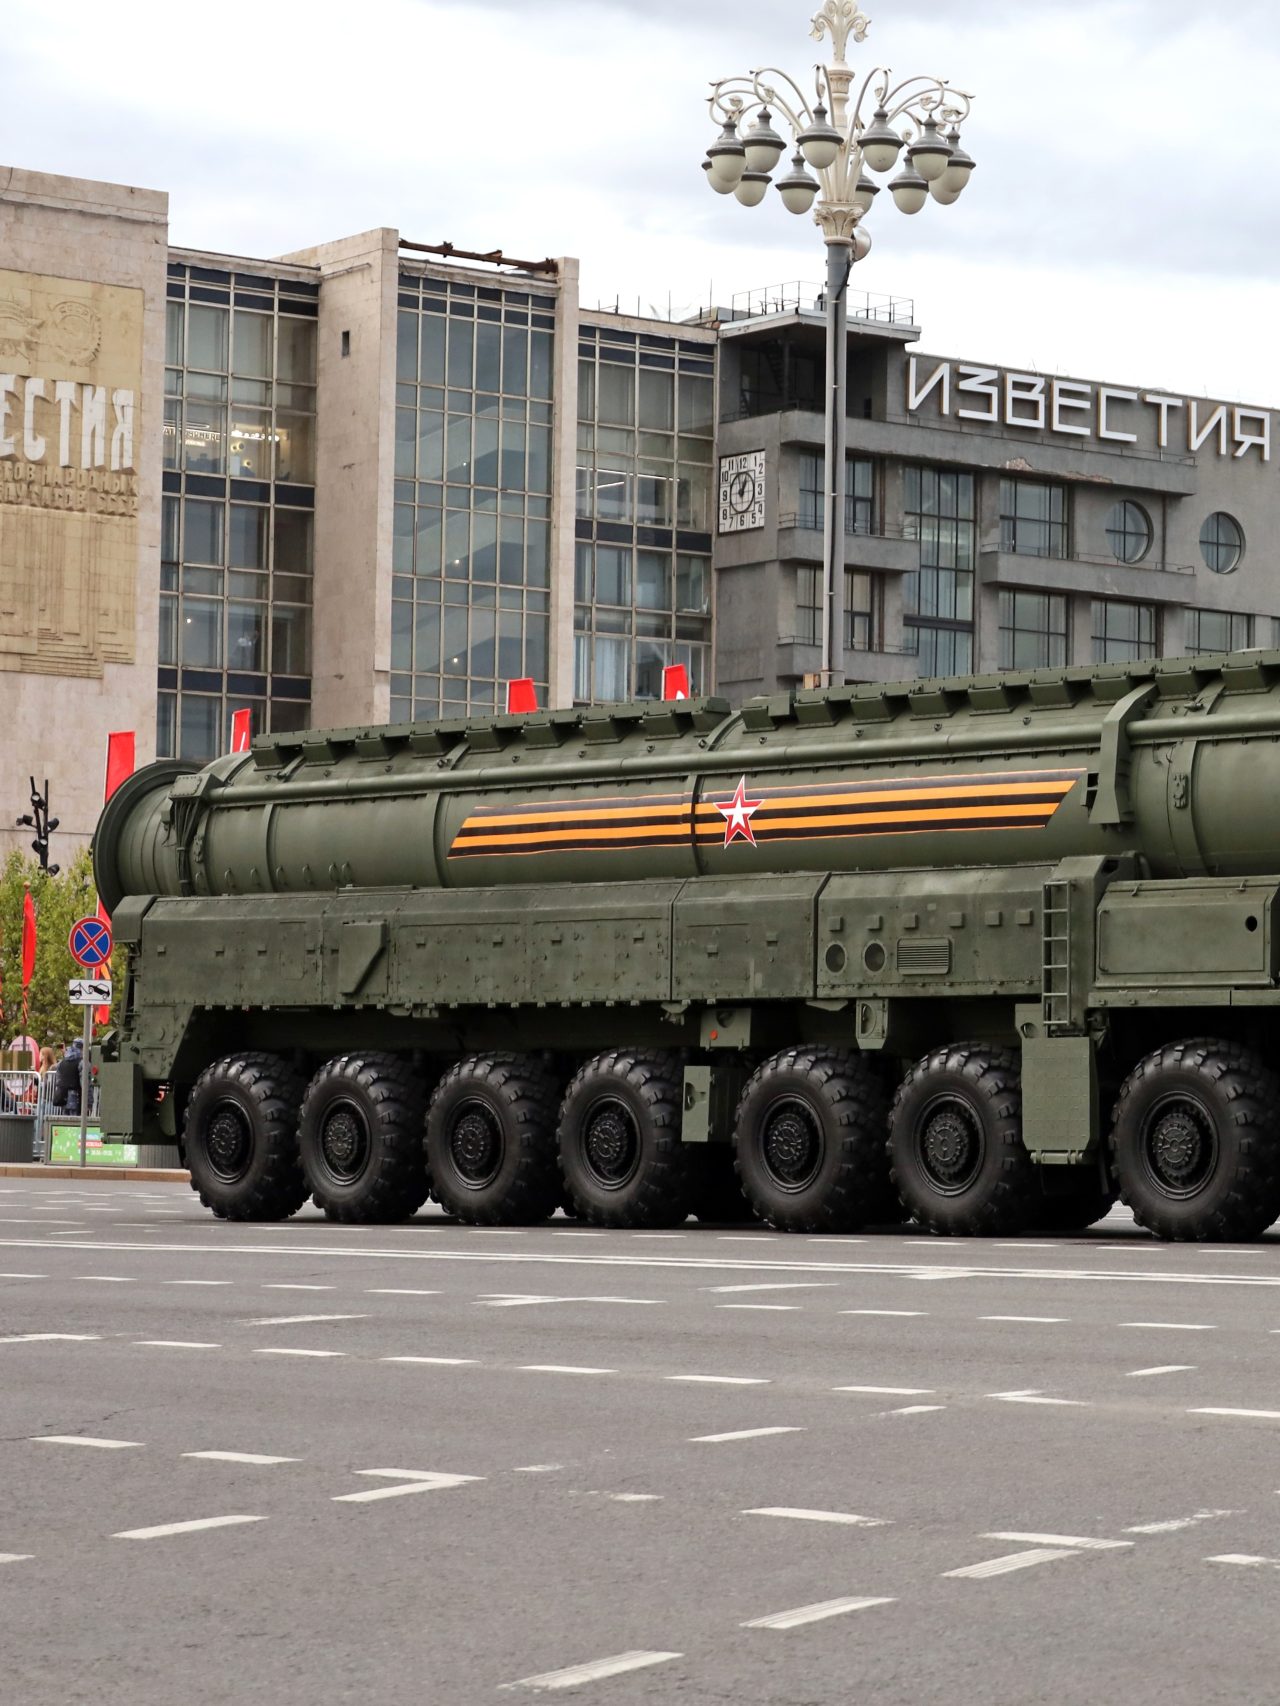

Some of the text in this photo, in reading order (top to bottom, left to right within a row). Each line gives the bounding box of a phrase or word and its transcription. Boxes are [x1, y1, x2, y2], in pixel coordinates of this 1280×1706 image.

[908, 357, 1271, 461] ИЗВЕСТИЯ
[0, 374, 134, 471] ЕСТИЯ
[728, 459, 734, 471] 11
[740, 457, 747, 469] 12
[759, 463, 764, 474] 2
[722, 471, 729, 482] 10
[758, 484, 763, 495] 3
[723, 490, 728, 501] 9
[723, 509, 728, 520] 8
[758, 503, 763, 515] 4
[729, 517, 734, 528] 7
[740, 515, 745, 526] 6
[751, 513, 756, 524] 5
